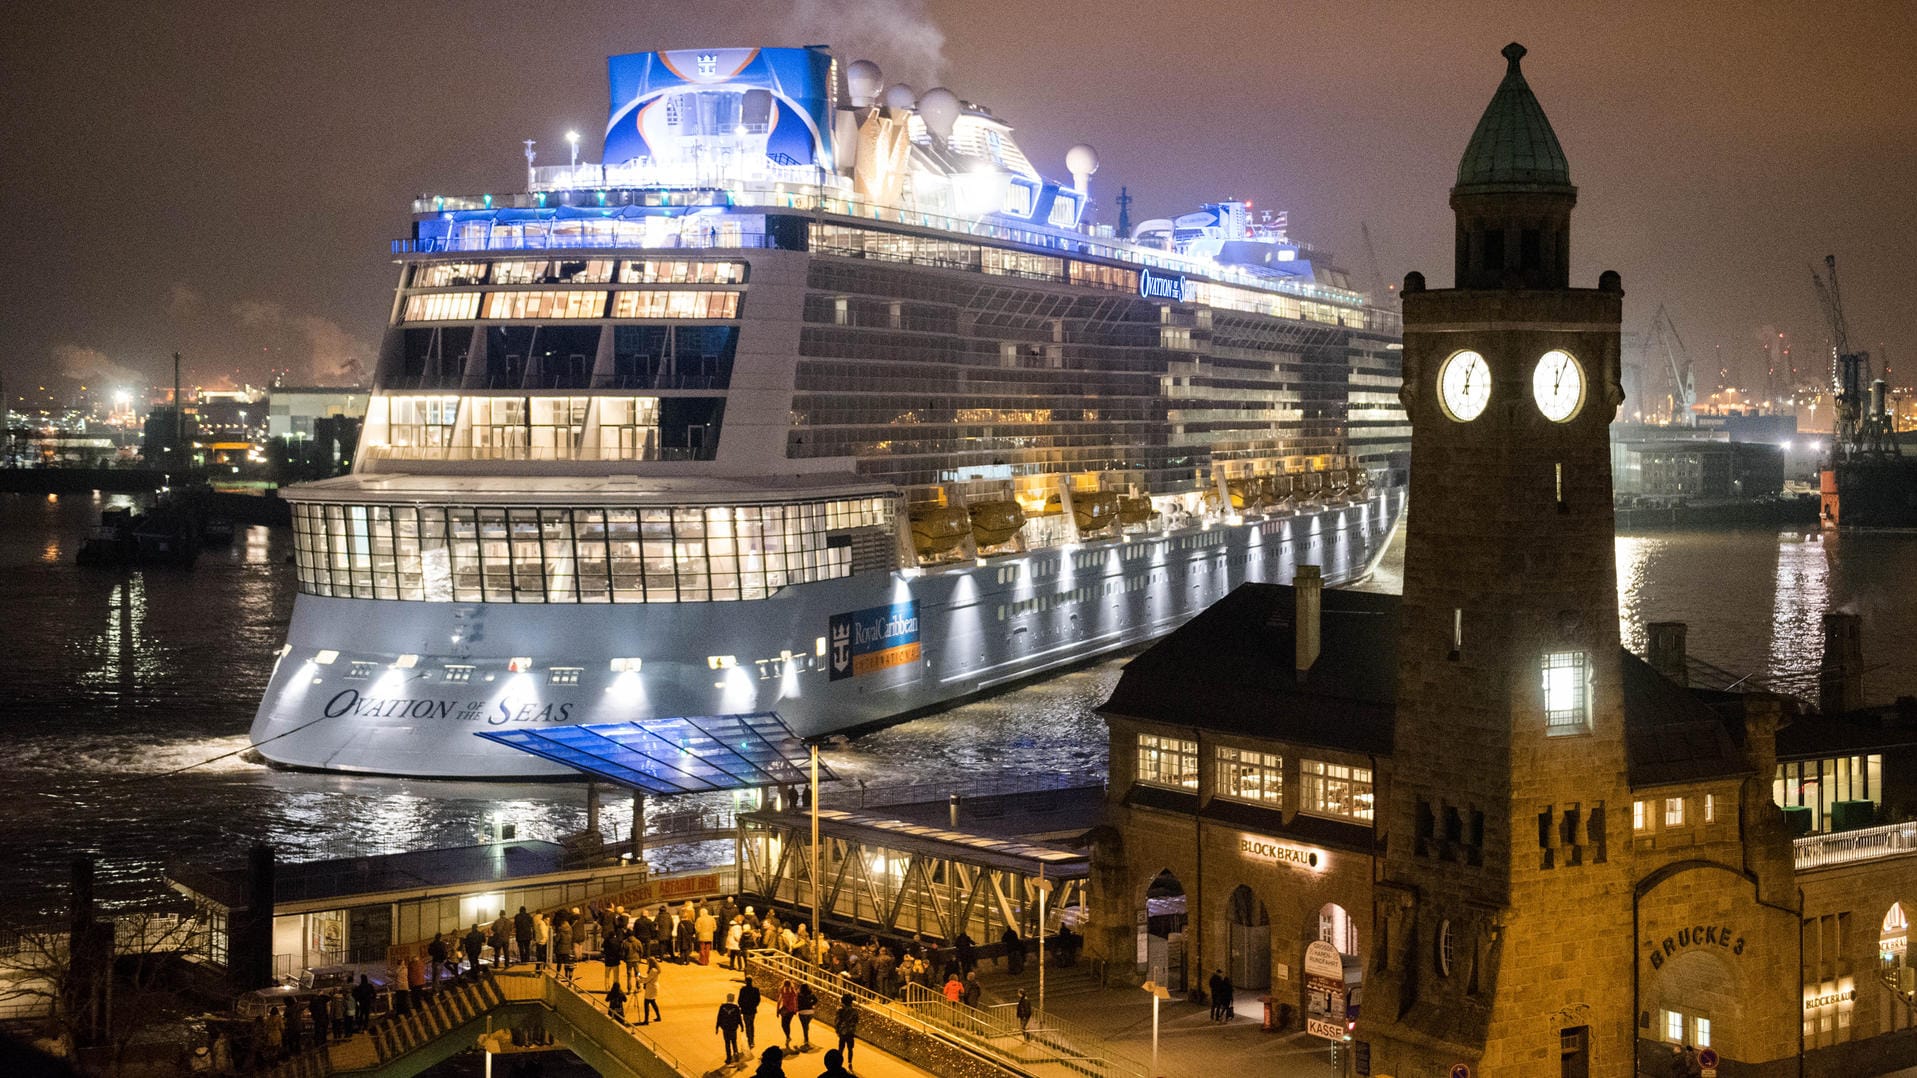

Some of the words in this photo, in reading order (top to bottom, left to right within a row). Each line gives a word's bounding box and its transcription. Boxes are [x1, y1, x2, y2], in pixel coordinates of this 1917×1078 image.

[855, 646, 920, 673] INTERNATIONAL
[324, 689, 455, 720] OVATION
[467, 700, 485, 711] OF
[488, 695, 573, 725] SEAS
[456, 710, 484, 720] THE
[1733, 937, 1745, 956] 3
[1309, 1020, 1343, 1038] KASSE
